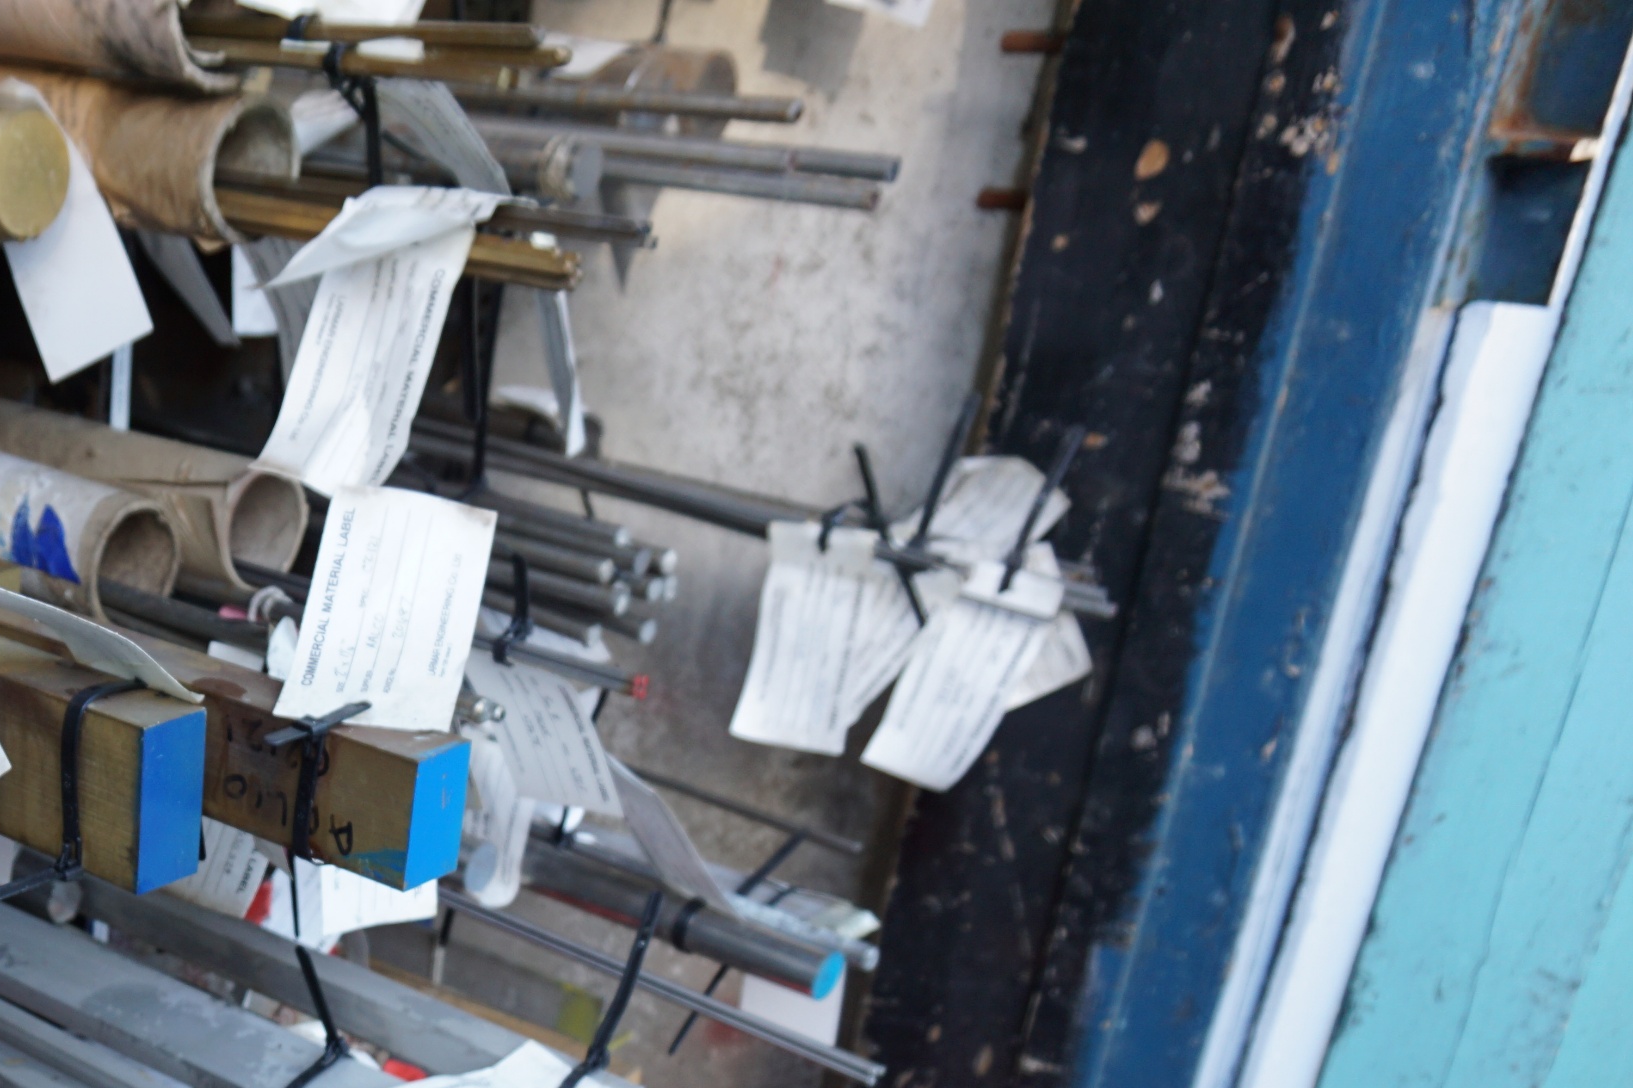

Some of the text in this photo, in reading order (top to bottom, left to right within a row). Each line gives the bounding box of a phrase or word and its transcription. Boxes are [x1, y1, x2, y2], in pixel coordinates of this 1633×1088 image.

[301, 616, 331, 687] COMMERCIAL
[324, 551, 346, 614] MATERIAL
[340, 507, 356, 549] LABEL
